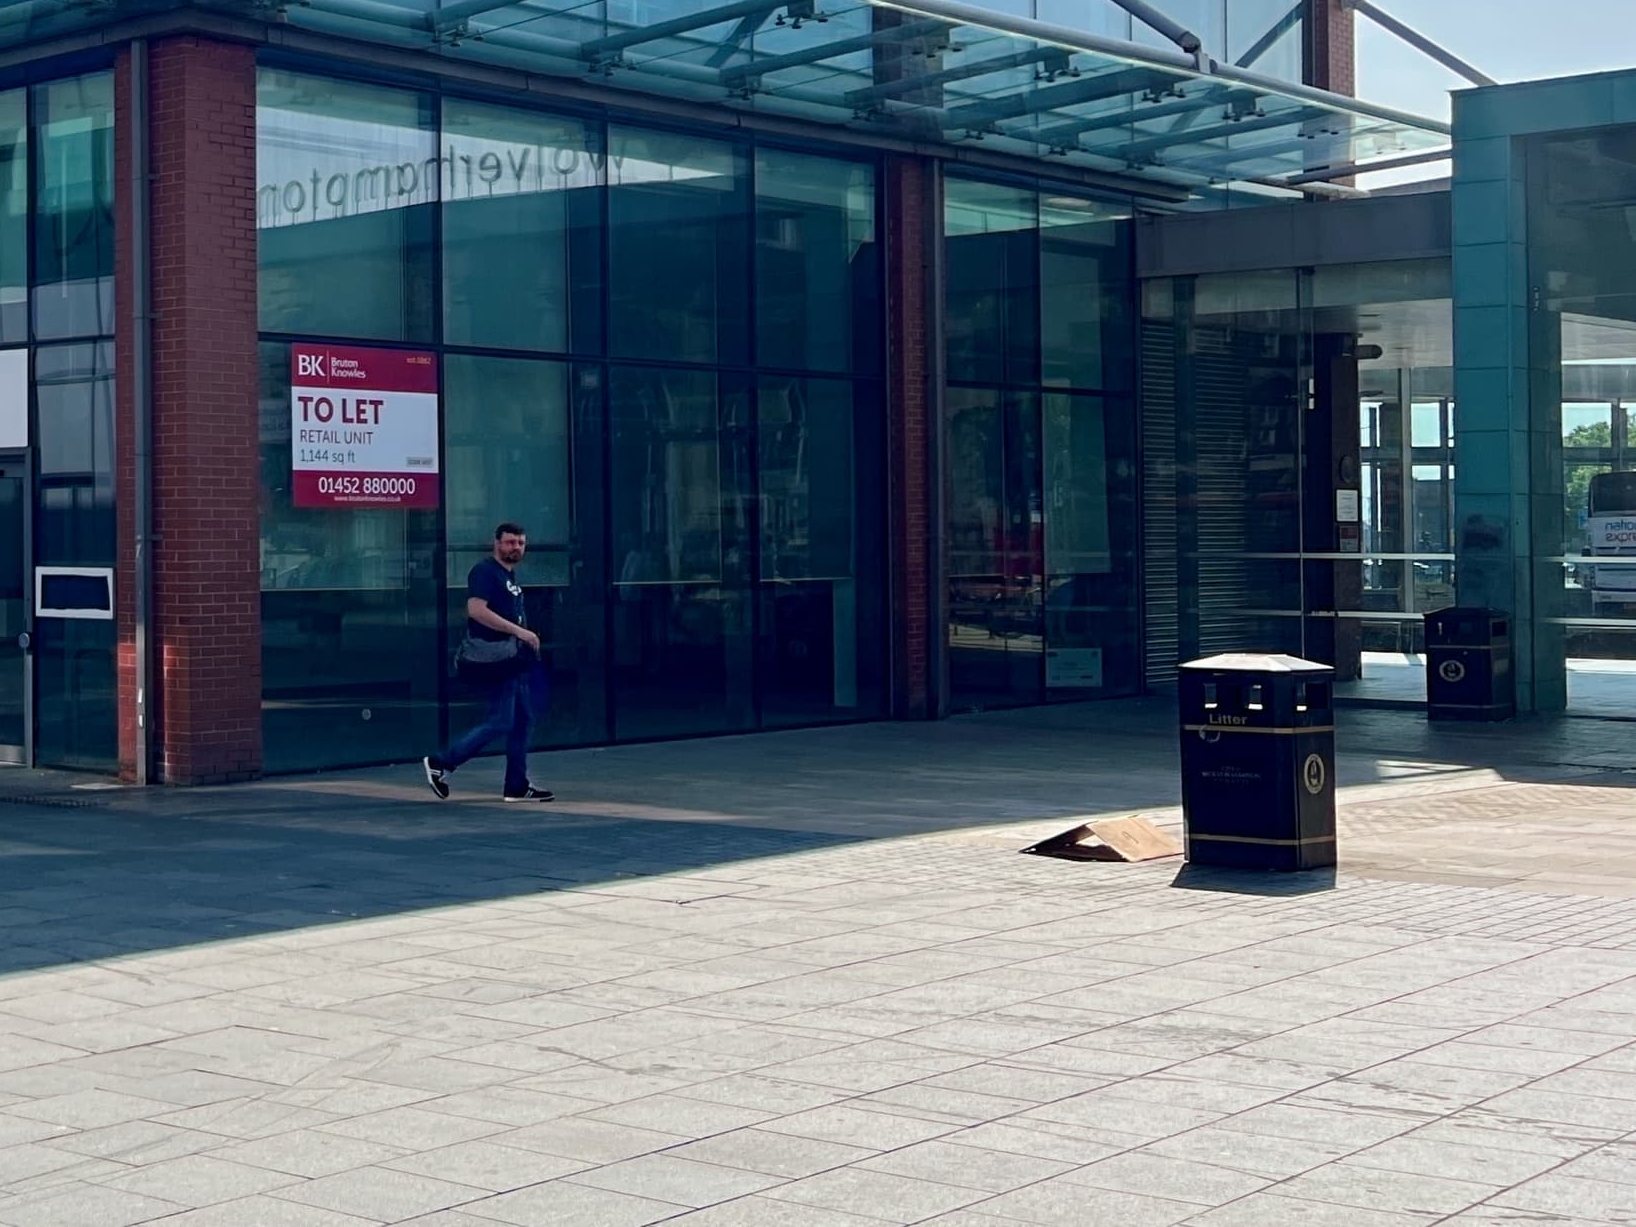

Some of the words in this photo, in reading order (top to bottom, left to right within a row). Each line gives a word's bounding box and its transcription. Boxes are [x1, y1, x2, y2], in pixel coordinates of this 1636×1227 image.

[297, 354, 326, 377] BK
[331, 357, 359, 368] Bruton
[331, 367, 366, 379] Knowles
[298, 396, 333, 423] TO
[341, 398, 384, 425] LET
[300, 429, 341, 445] RETAIL
[344, 431, 374, 446] UNIT
[300, 449, 329, 463] 1,144
[331, 452, 345, 465] sq
[347, 450, 356, 463] ft
[318, 476, 360, 494] 01452
[363, 477, 416, 495] 880000
[1209, 713, 1248, 724] Litter
